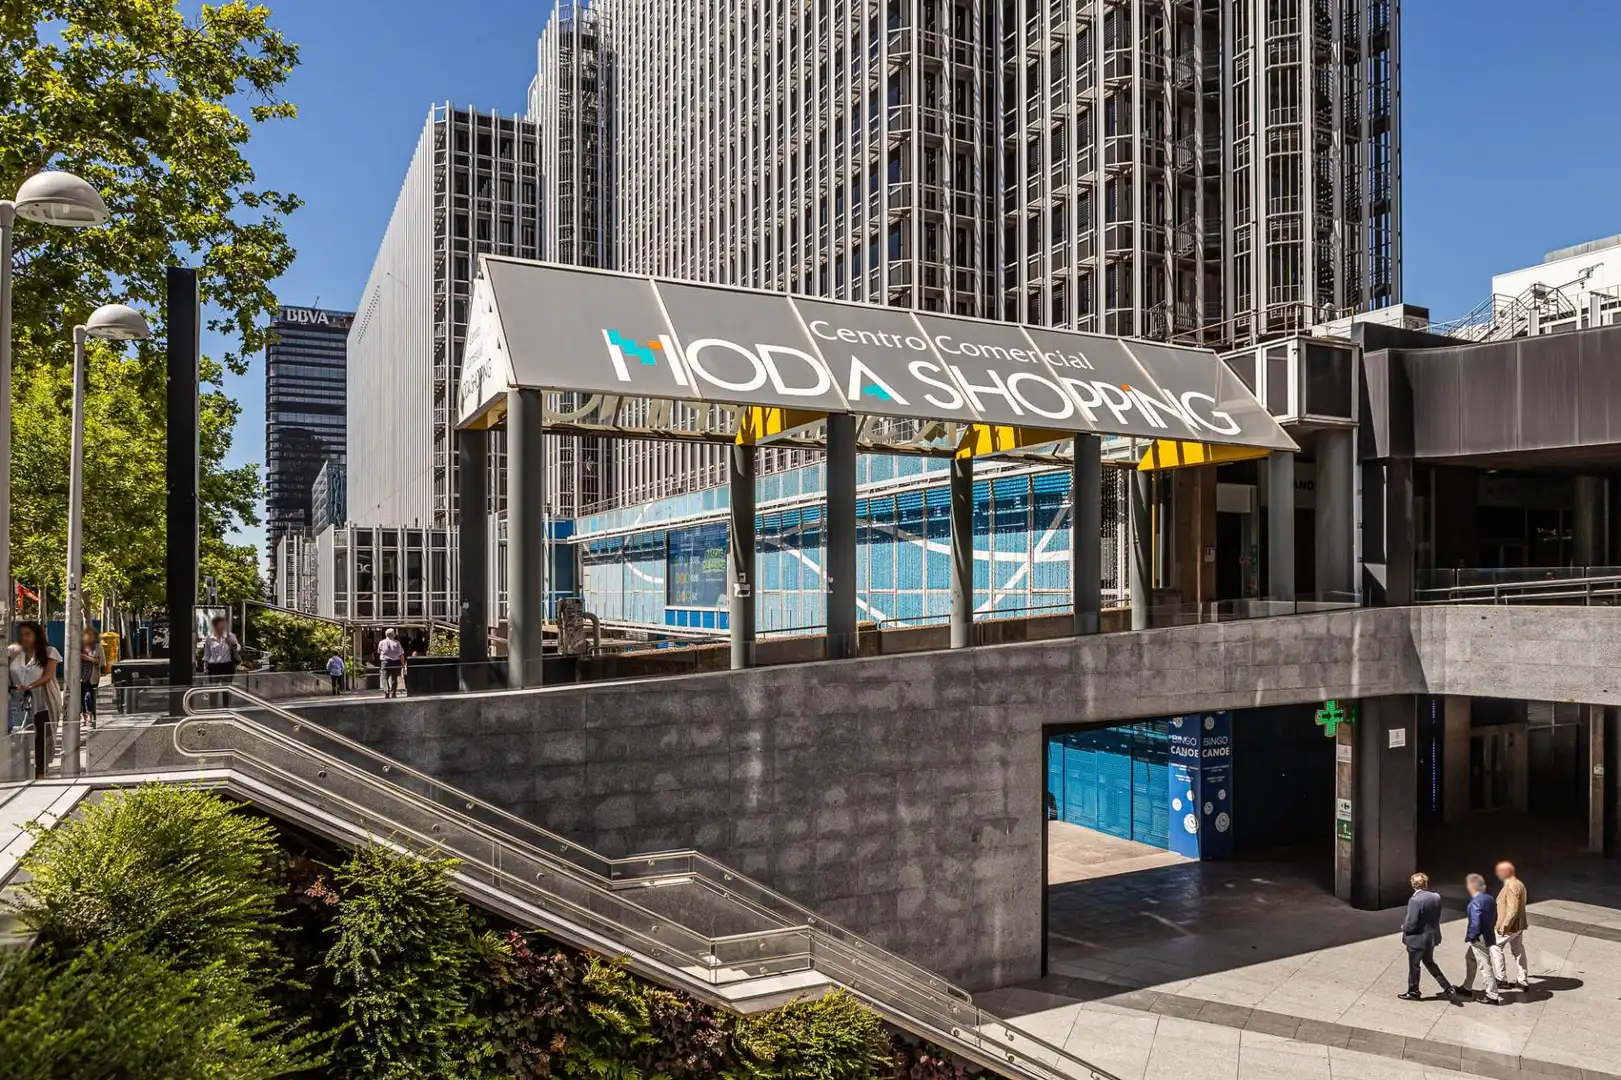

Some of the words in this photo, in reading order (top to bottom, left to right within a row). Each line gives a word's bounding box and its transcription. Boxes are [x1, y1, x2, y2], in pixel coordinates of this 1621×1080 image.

[287, 308, 329, 325] BBVA
[809, 320, 926, 351] Centro
[934, 335, 1095, 370] Comercial
[1172, 735, 1197, 746] BINGO
[1203, 735, 1229, 746] BINGO
[1170, 745, 1199, 758] CANOE
[1202, 747, 1230, 758] CANOE
